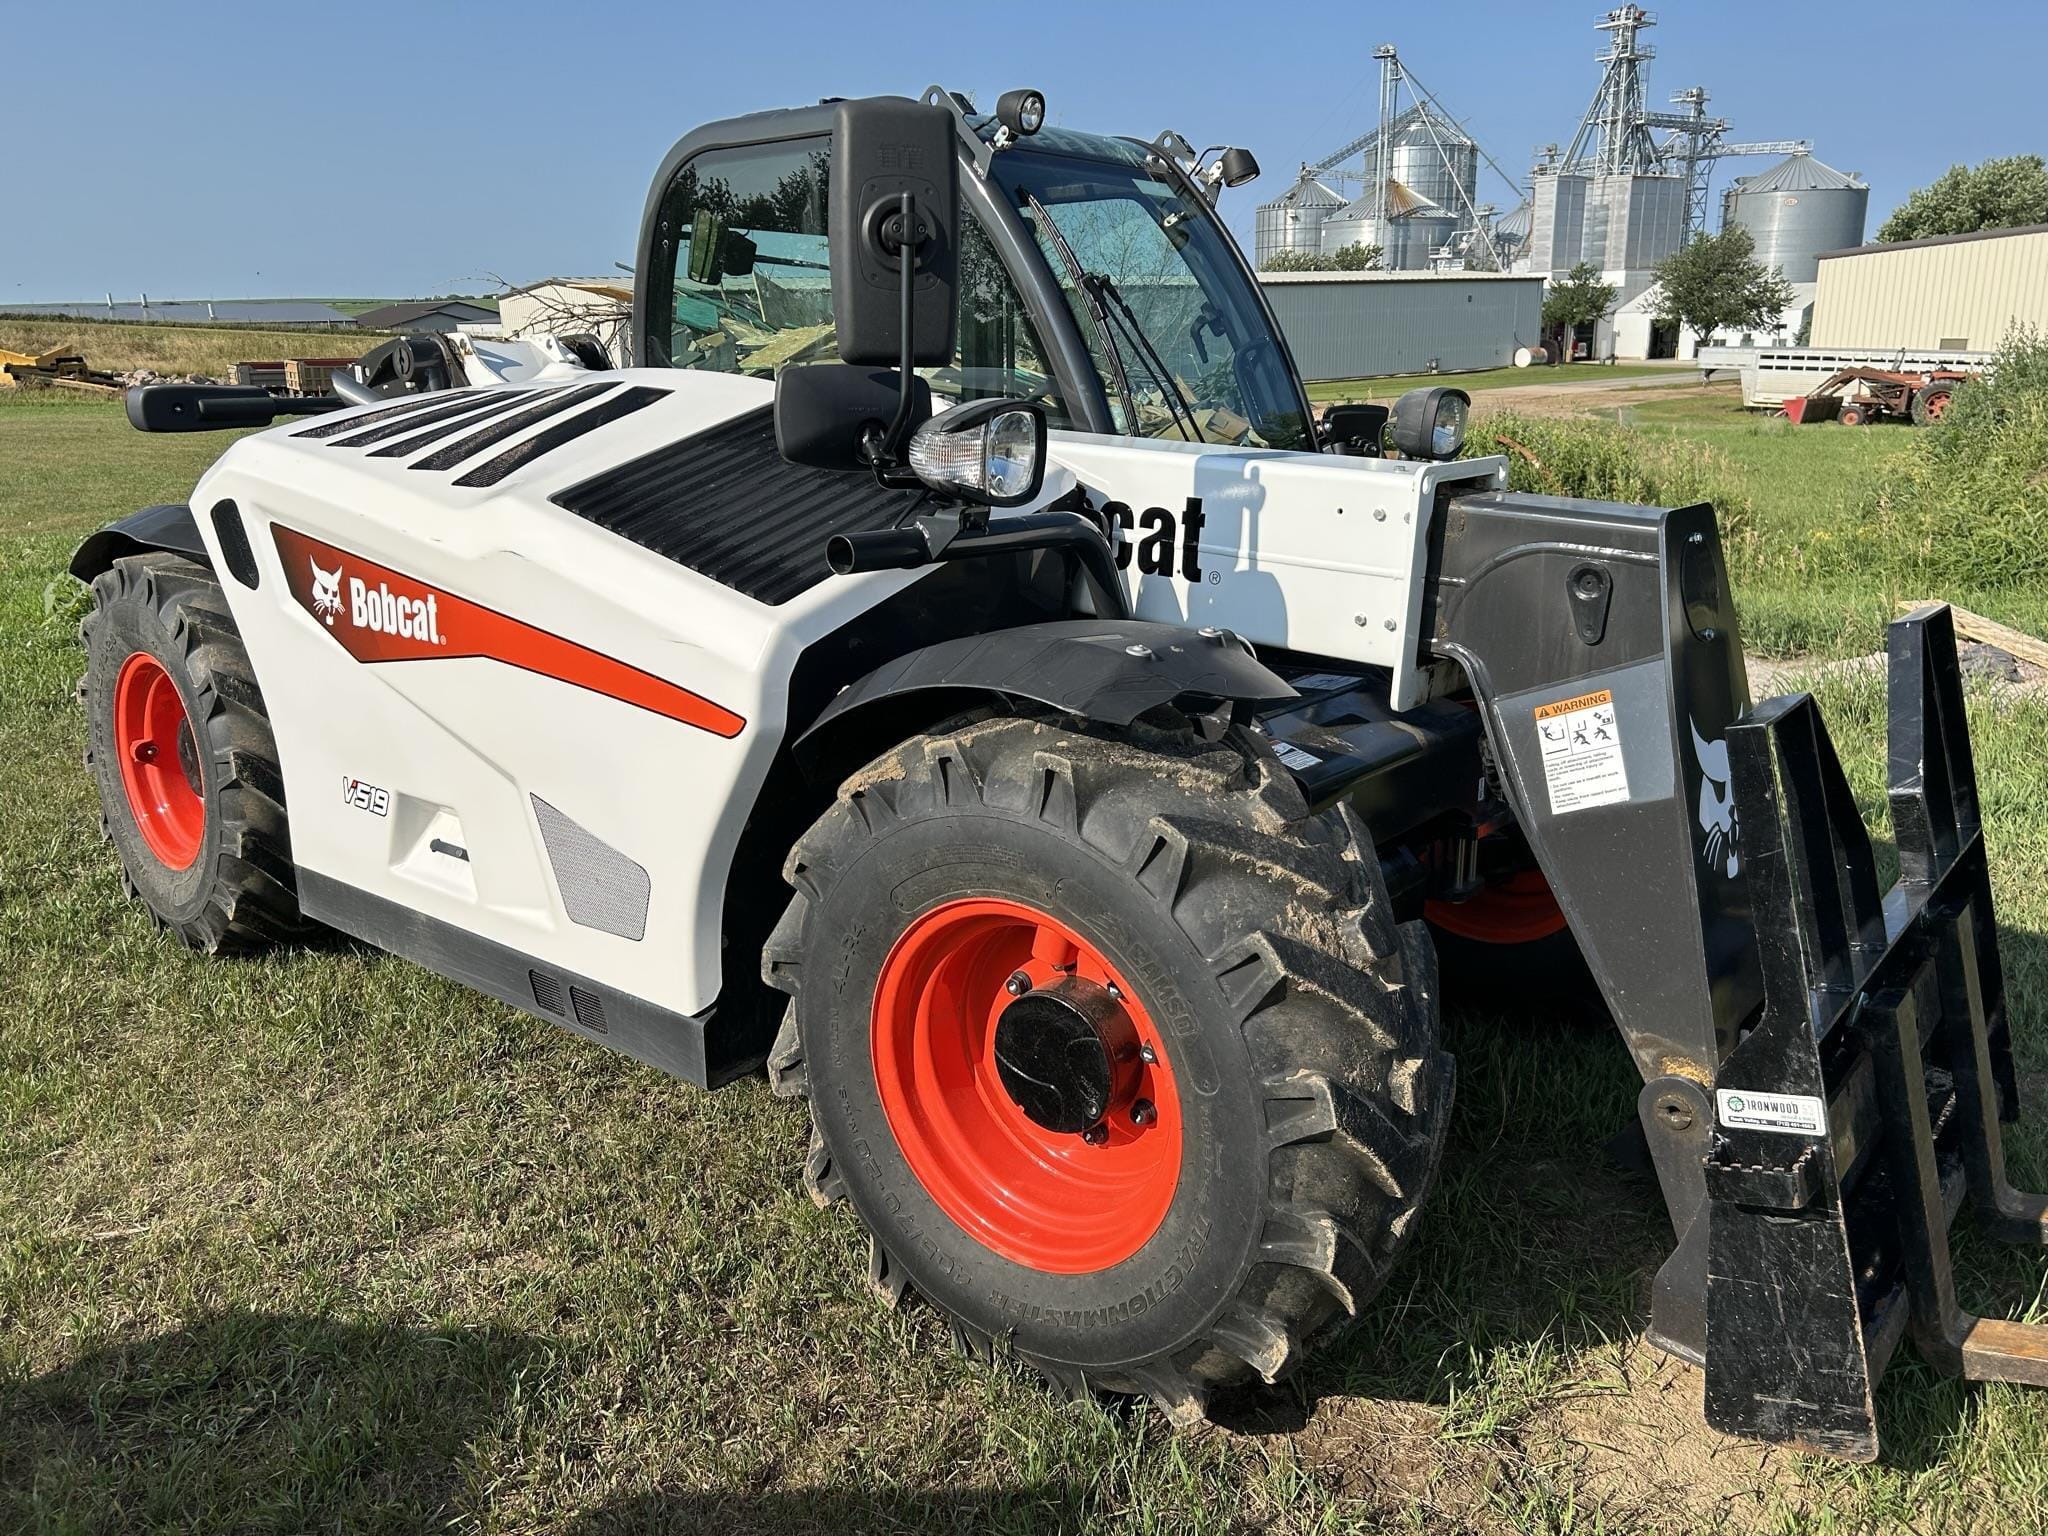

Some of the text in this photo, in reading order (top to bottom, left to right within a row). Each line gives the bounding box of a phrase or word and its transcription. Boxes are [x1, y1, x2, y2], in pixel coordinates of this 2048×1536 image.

[349, 577, 439, 645] Bobcat
[1552, 693, 1608, 714] WARNING
[343, 776, 390, 817] V519
[1745, 1099, 1799, 1114] IRONWOOD
[989, 1214, 1213, 1329] TRACTIONMASTER
